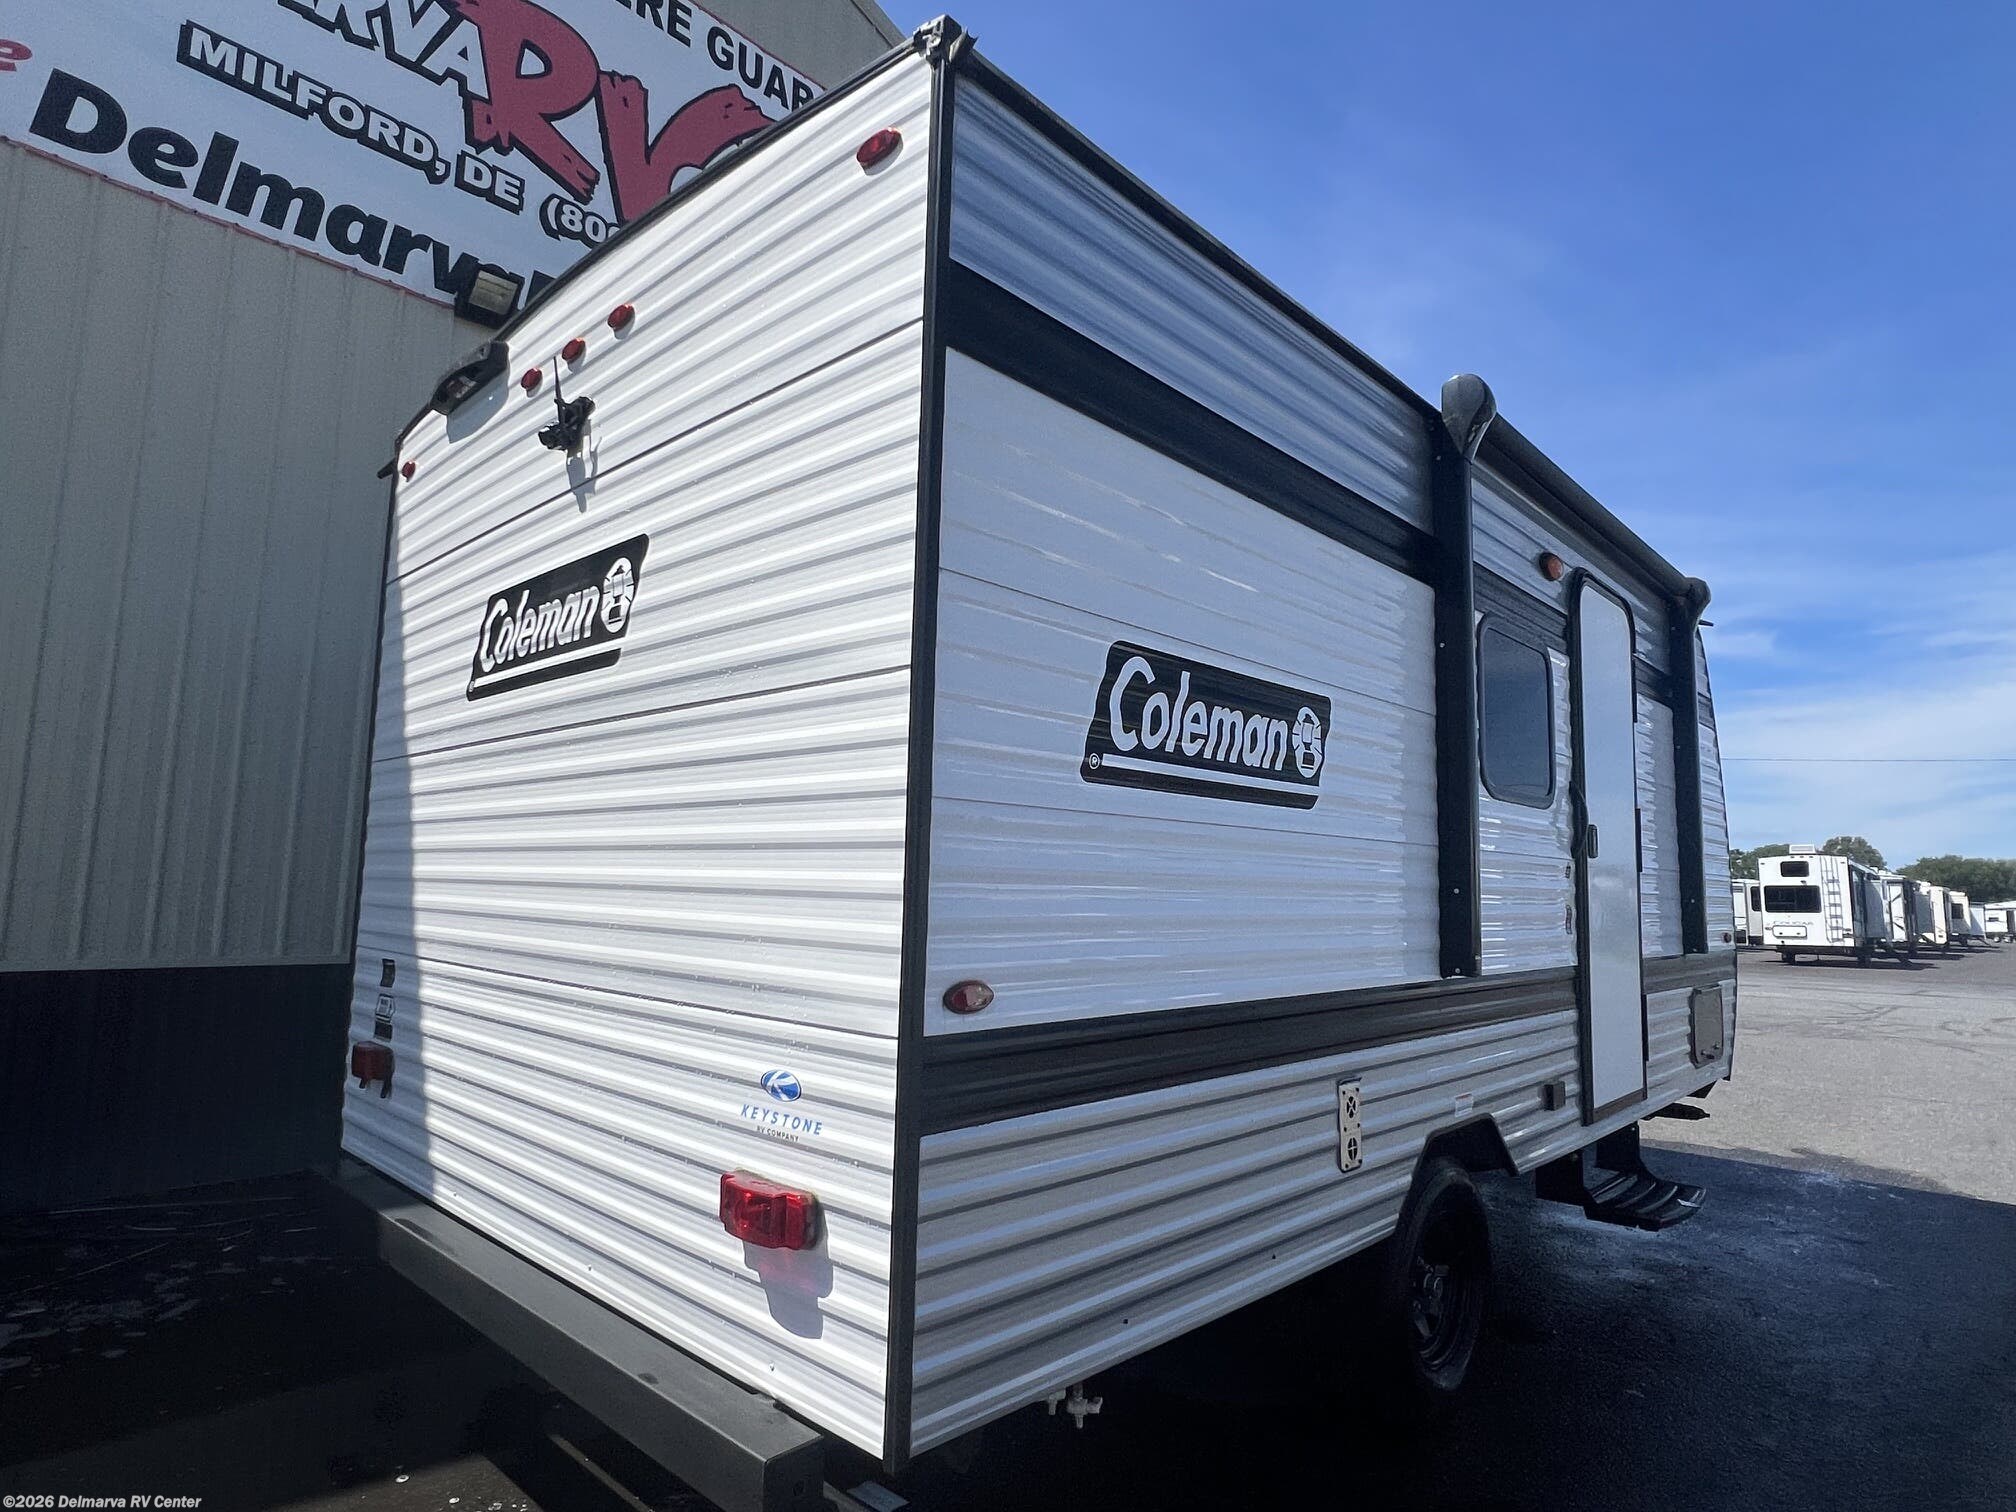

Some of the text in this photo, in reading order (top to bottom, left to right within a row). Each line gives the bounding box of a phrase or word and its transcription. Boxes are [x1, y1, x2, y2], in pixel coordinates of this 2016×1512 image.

[613, 0, 692, 47] RE
[177, 20, 622, 249] MILFORD, DE (80
[479, 590, 601, 673] Coleman
[1110, 656, 1289, 771] Coleman
[740, 1104, 823, 1135] KEYSTONE
[767, 1128, 799, 1142] COMPANY
